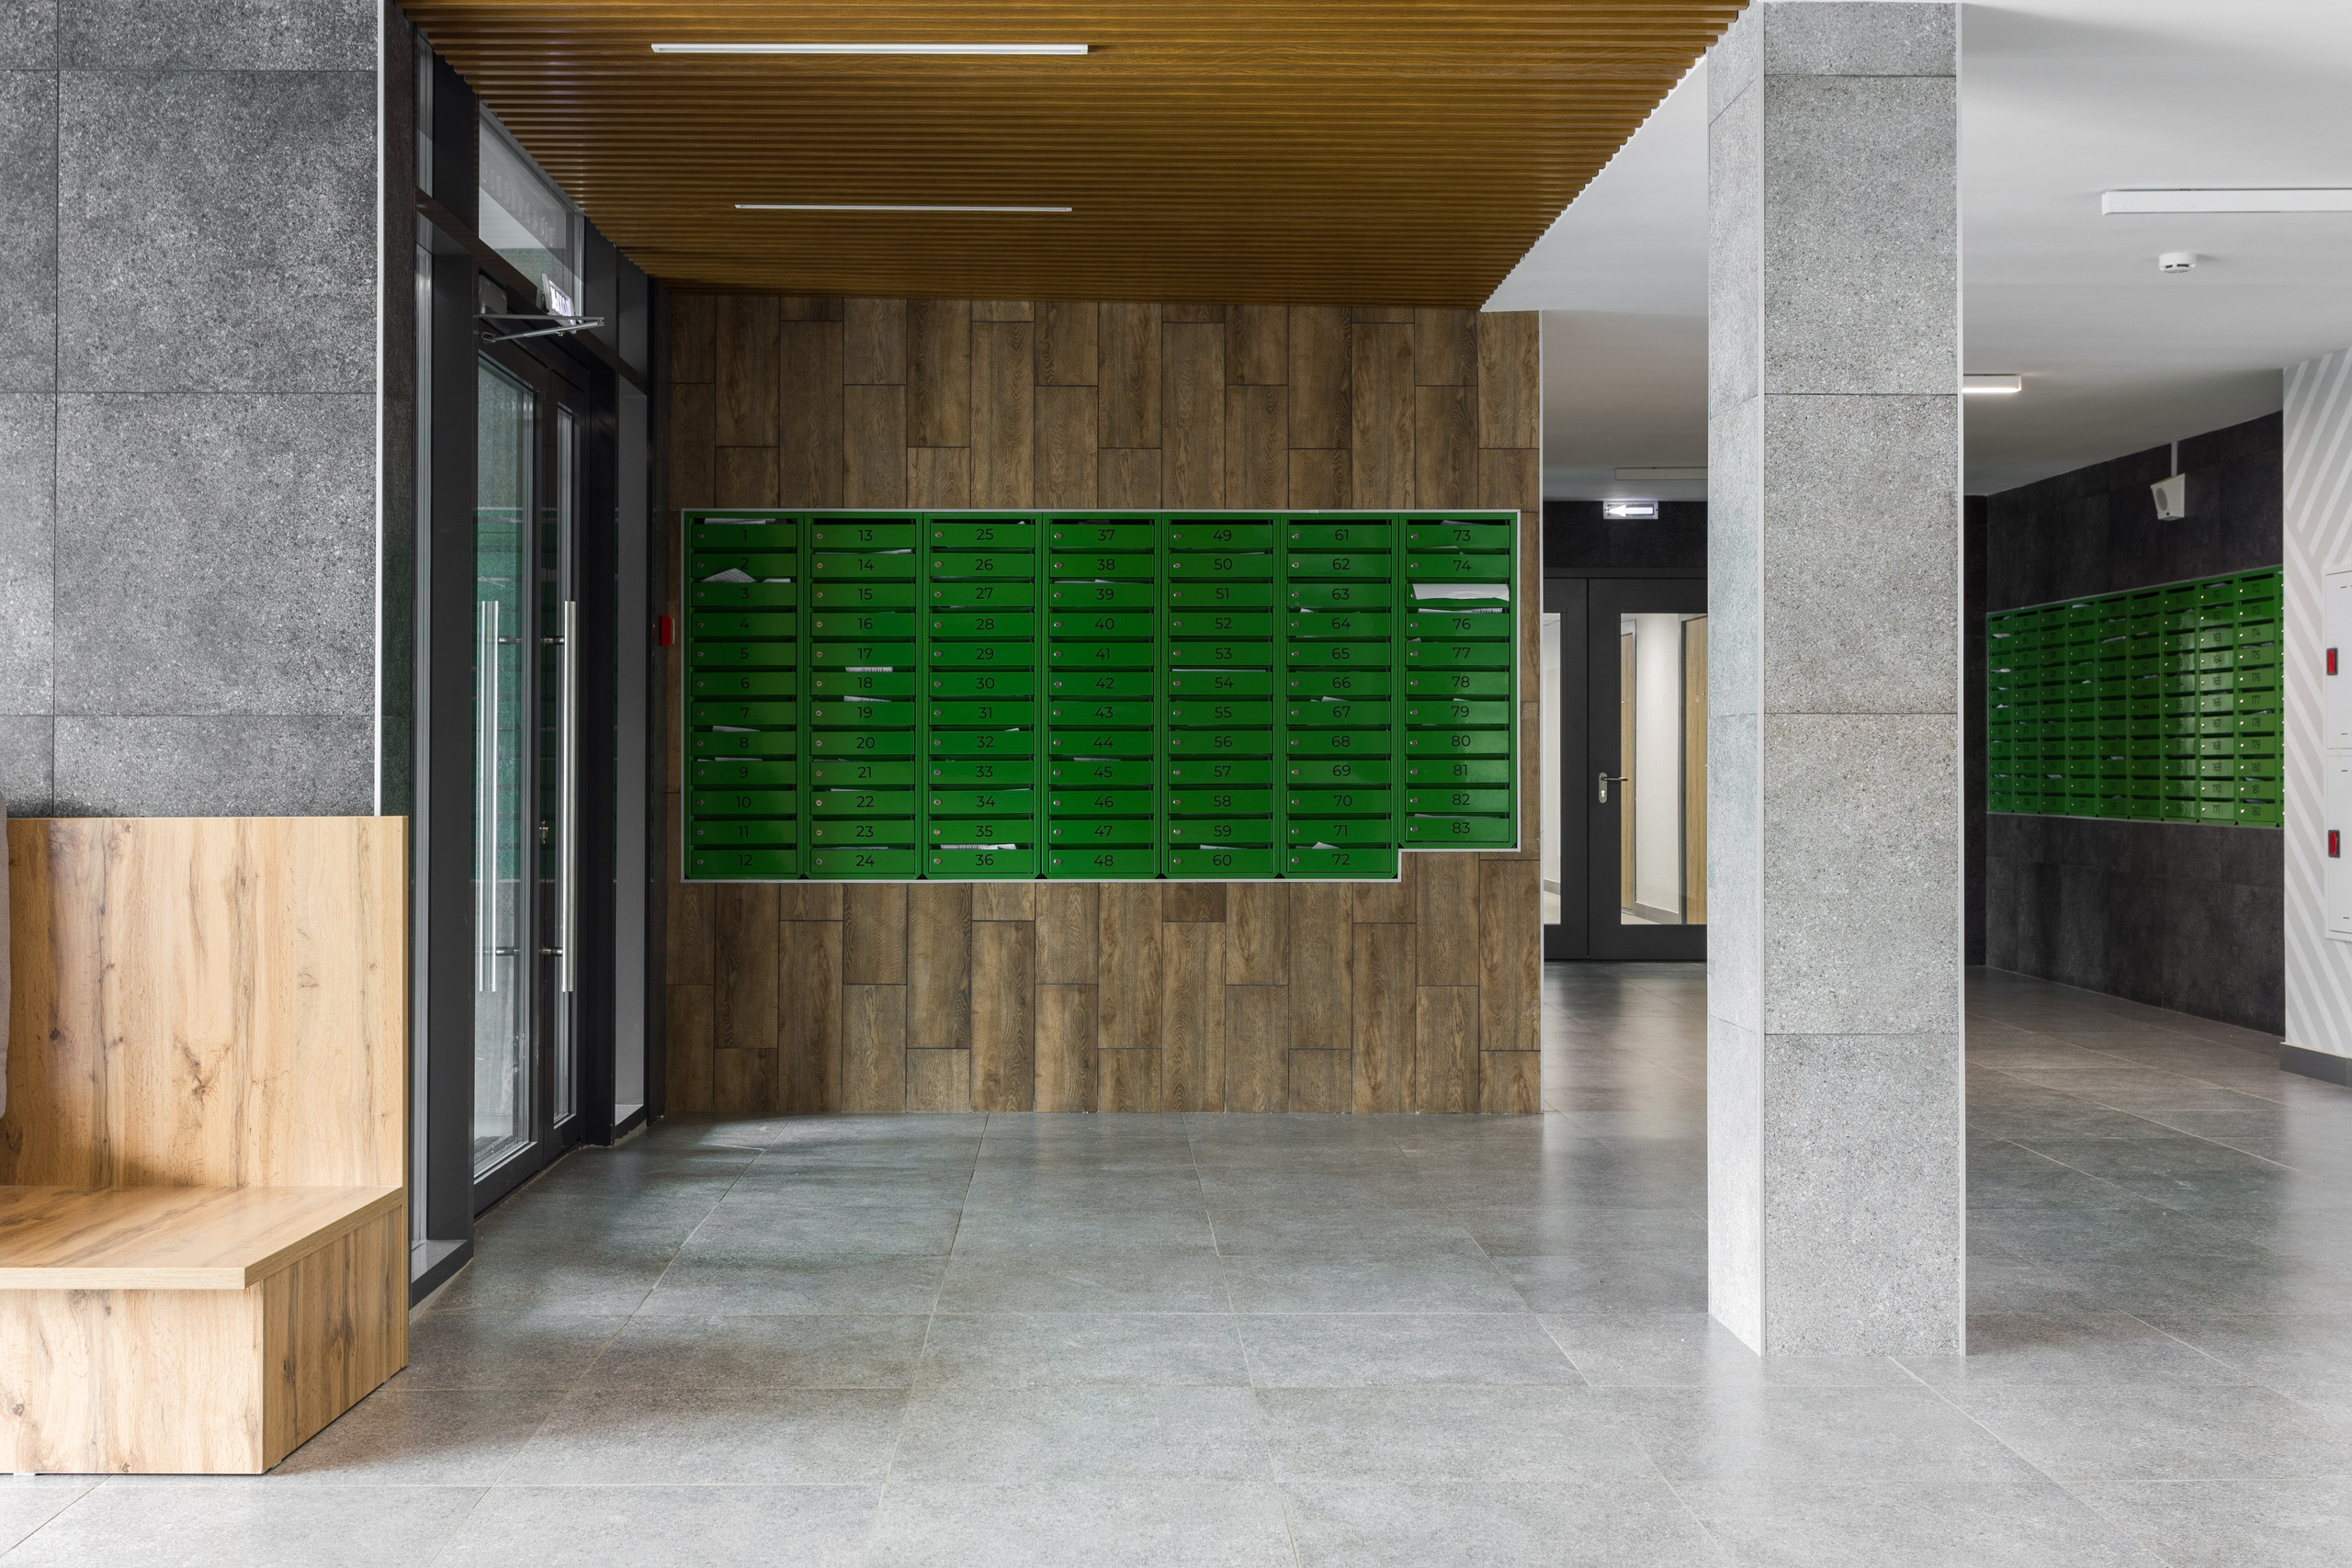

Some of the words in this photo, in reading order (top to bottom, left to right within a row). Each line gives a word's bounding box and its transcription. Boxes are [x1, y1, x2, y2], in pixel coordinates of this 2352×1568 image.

[742, 530, 748, 542] 1
[858, 530, 873, 541] 13
[977, 528, 993, 540] 25
[1098, 529, 1114, 541] 37
[1213, 530, 1232, 541] 49
[1335, 529, 1349, 541] 61
[1453, 530, 1470, 541] 73
[741, 558, 750, 570] 2
[858, 559, 874, 570] 14
[975, 558, 993, 570] 26
[1097, 558, 1115, 570] 38
[1215, 558, 1232, 570] 50
[1332, 558, 1350, 570] 62
[1453, 560, 1472, 571] 74
[741, 588, 750, 599] 3
[976, 588, 993, 599] 27
[1216, 588, 1228, 599] 51
[2252, 583, 2260, 592] 172
[858, 589, 873, 600] 15
[1096, 589, 1114, 600] 39
[1332, 588, 1350, 600] 63
[2252, 606, 2260, 615] 173
[740, 617, 750, 629] 4
[858, 618, 873, 629] 16
[976, 618, 994, 630] 28
[1095, 618, 1114, 629] 40
[1215, 617, 1232, 629] 52
[1332, 617, 1351, 629] 64
[1453, 618, 1471, 629] 76
[2252, 628, 2260, 637] 174
[740, 648, 749, 660] 5
[857, 648, 872, 660] 17
[976, 648, 994, 660] 29
[1096, 648, 1110, 660] 41
[1215, 648, 1232, 660] 53
[1332, 648, 1350, 660] 65
[1453, 647, 1470, 659] 77
[2252, 650, 2260, 660] 175
[2212, 655, 2222, 664] 164
[741, 677, 750, 689] 6
[857, 677, 873, 689] 18
[976, 677, 995, 689] 30
[1096, 677, 1114, 689] 42
[1215, 677, 1234, 688] 54
[1332, 677, 1351, 689] 66
[1452, 676, 1470, 688] 78
[2212, 677, 2221, 685] 165
[2252, 672, 2260, 682] 176
[2212, 698, 2221, 706] 166
[2252, 695, 2260, 704] 177
[741, 707, 750, 719] 7
[857, 706, 872, 718] 19
[978, 707, 991, 718] 31
[1095, 706, 1113, 718] 43
[1215, 706, 1232, 718] 55
[1333, 706, 1351, 717] 67
[1452, 705, 1469, 717] 79
[2212, 719, 2221, 728] 167
[2252, 717, 2260, 727] 178
[740, 737, 749, 749] 8
[856, 737, 875, 749] 20
[977, 736, 994, 748] 32
[1093, 737, 1114, 748] 44
[1215, 736, 1232, 748] 56
[1331, 736, 1351, 747] 68
[1452, 735, 1470, 747] 80
[2212, 741, 2221, 750] 168
[2252, 740, 2260, 749] 179
[739, 766, 748, 778] 9
[858, 766, 871, 778] 21
[976, 766, 993, 777] 33
[1094, 766, 1112, 778] 45
[1214, 766, 1231, 777] 57
[1333, 765, 1351, 776] 69
[1453, 764, 1467, 776] 81
[2212, 763, 2221, 772] 169
[2252, 762, 2260, 772] 180
[2212, 784, 2221, 793] 170
[735, 796, 752, 808] 10
[856, 795, 874, 807] 22
[977, 795, 996, 807] 34
[1094, 795, 1114, 807] 46
[1214, 795, 1231, 807] 58
[1334, 795, 1352, 807] 70
[1453, 794, 1470, 806] 82
[2252, 807, 2261, 816] 182
[738, 826, 748, 838] 11
[856, 826, 874, 838] 23
[976, 826, 993, 837] 35
[1094, 825, 1113, 837] 47
[1214, 825, 1231, 837] 59
[1334, 825, 1347, 836] 71
[1453, 822, 1470, 834] 83
[738, 854, 752, 866] 12
[856, 855, 875, 866] 24
[976, 854, 993, 866] 36
[1094, 855, 1114, 866] 48
[1213, 854, 1231, 866] 60
[1332, 853, 1350, 865] 72
